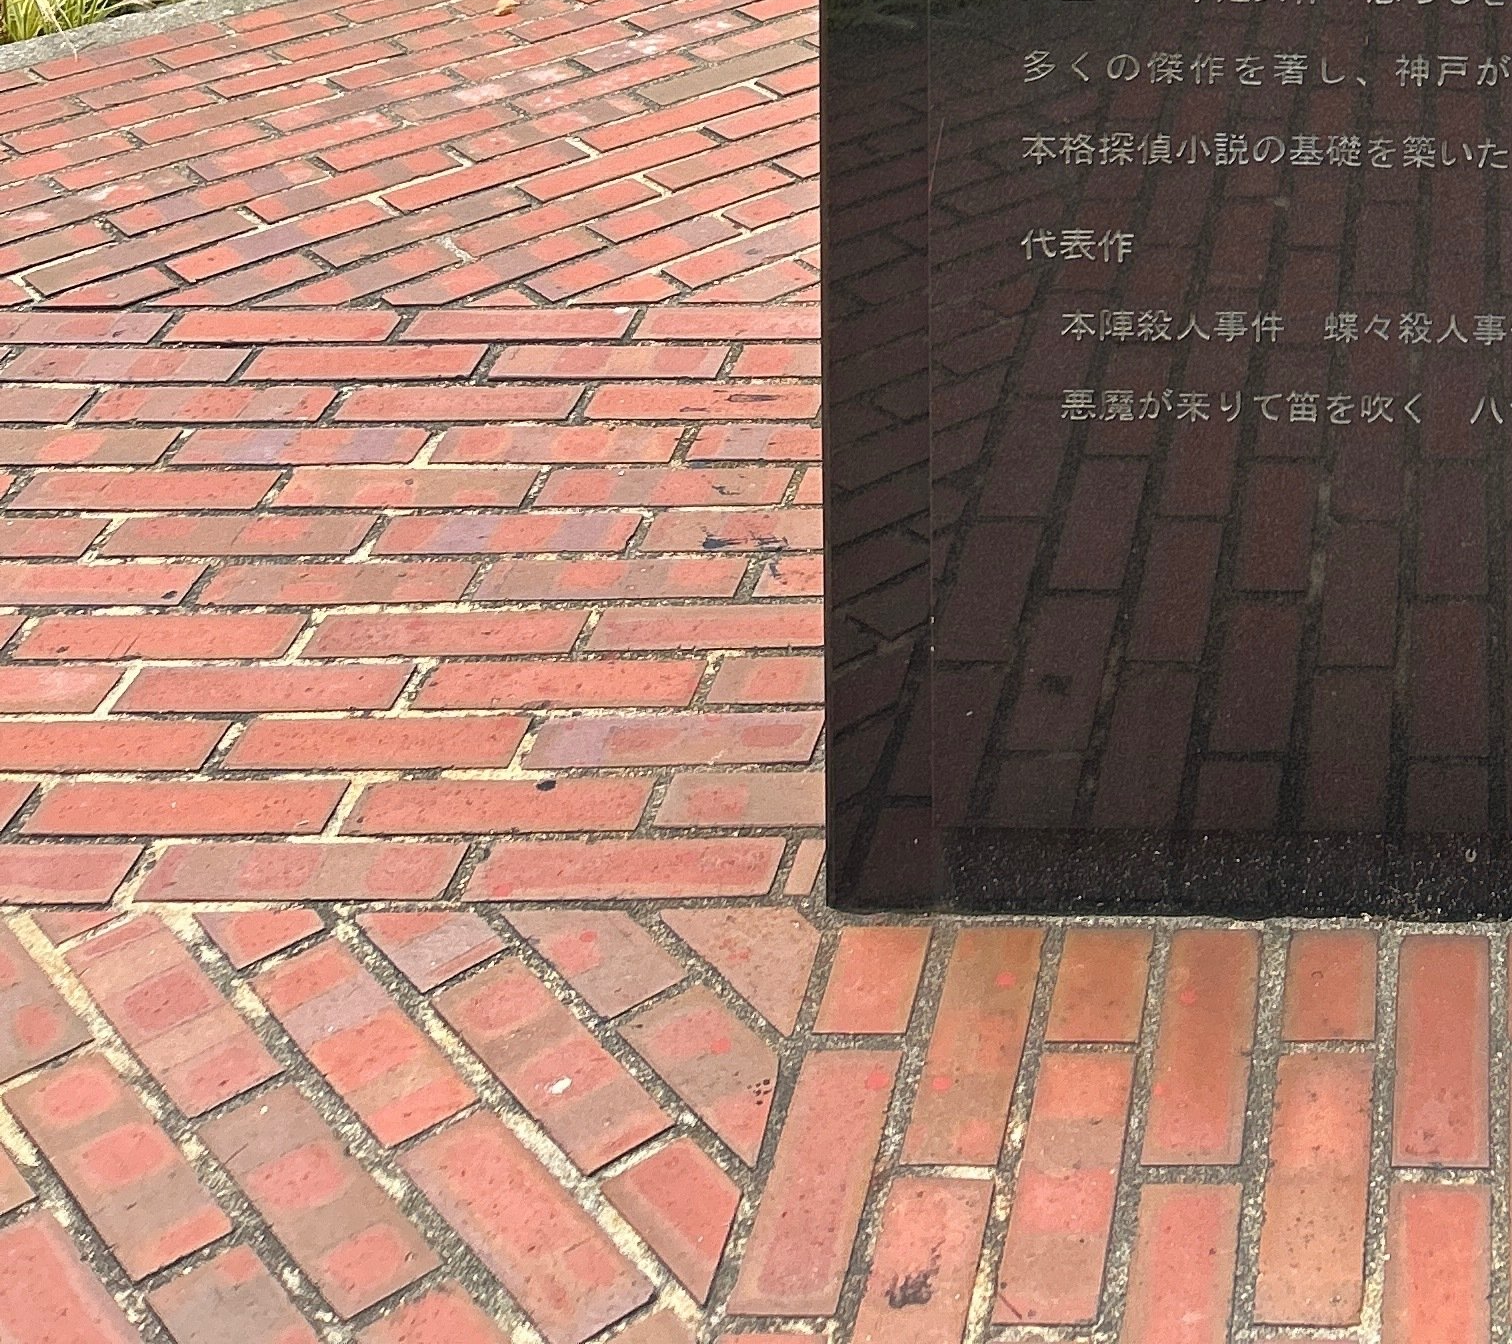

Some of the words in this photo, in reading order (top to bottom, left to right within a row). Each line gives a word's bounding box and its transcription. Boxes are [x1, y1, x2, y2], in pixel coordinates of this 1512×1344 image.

[1020, 228, 1136, 264] 代表作
[1060, 308, 1286, 345] 本陣殺人事件
[1060, 388, 1424, 426] 悪魔が来りて笛を吹く
